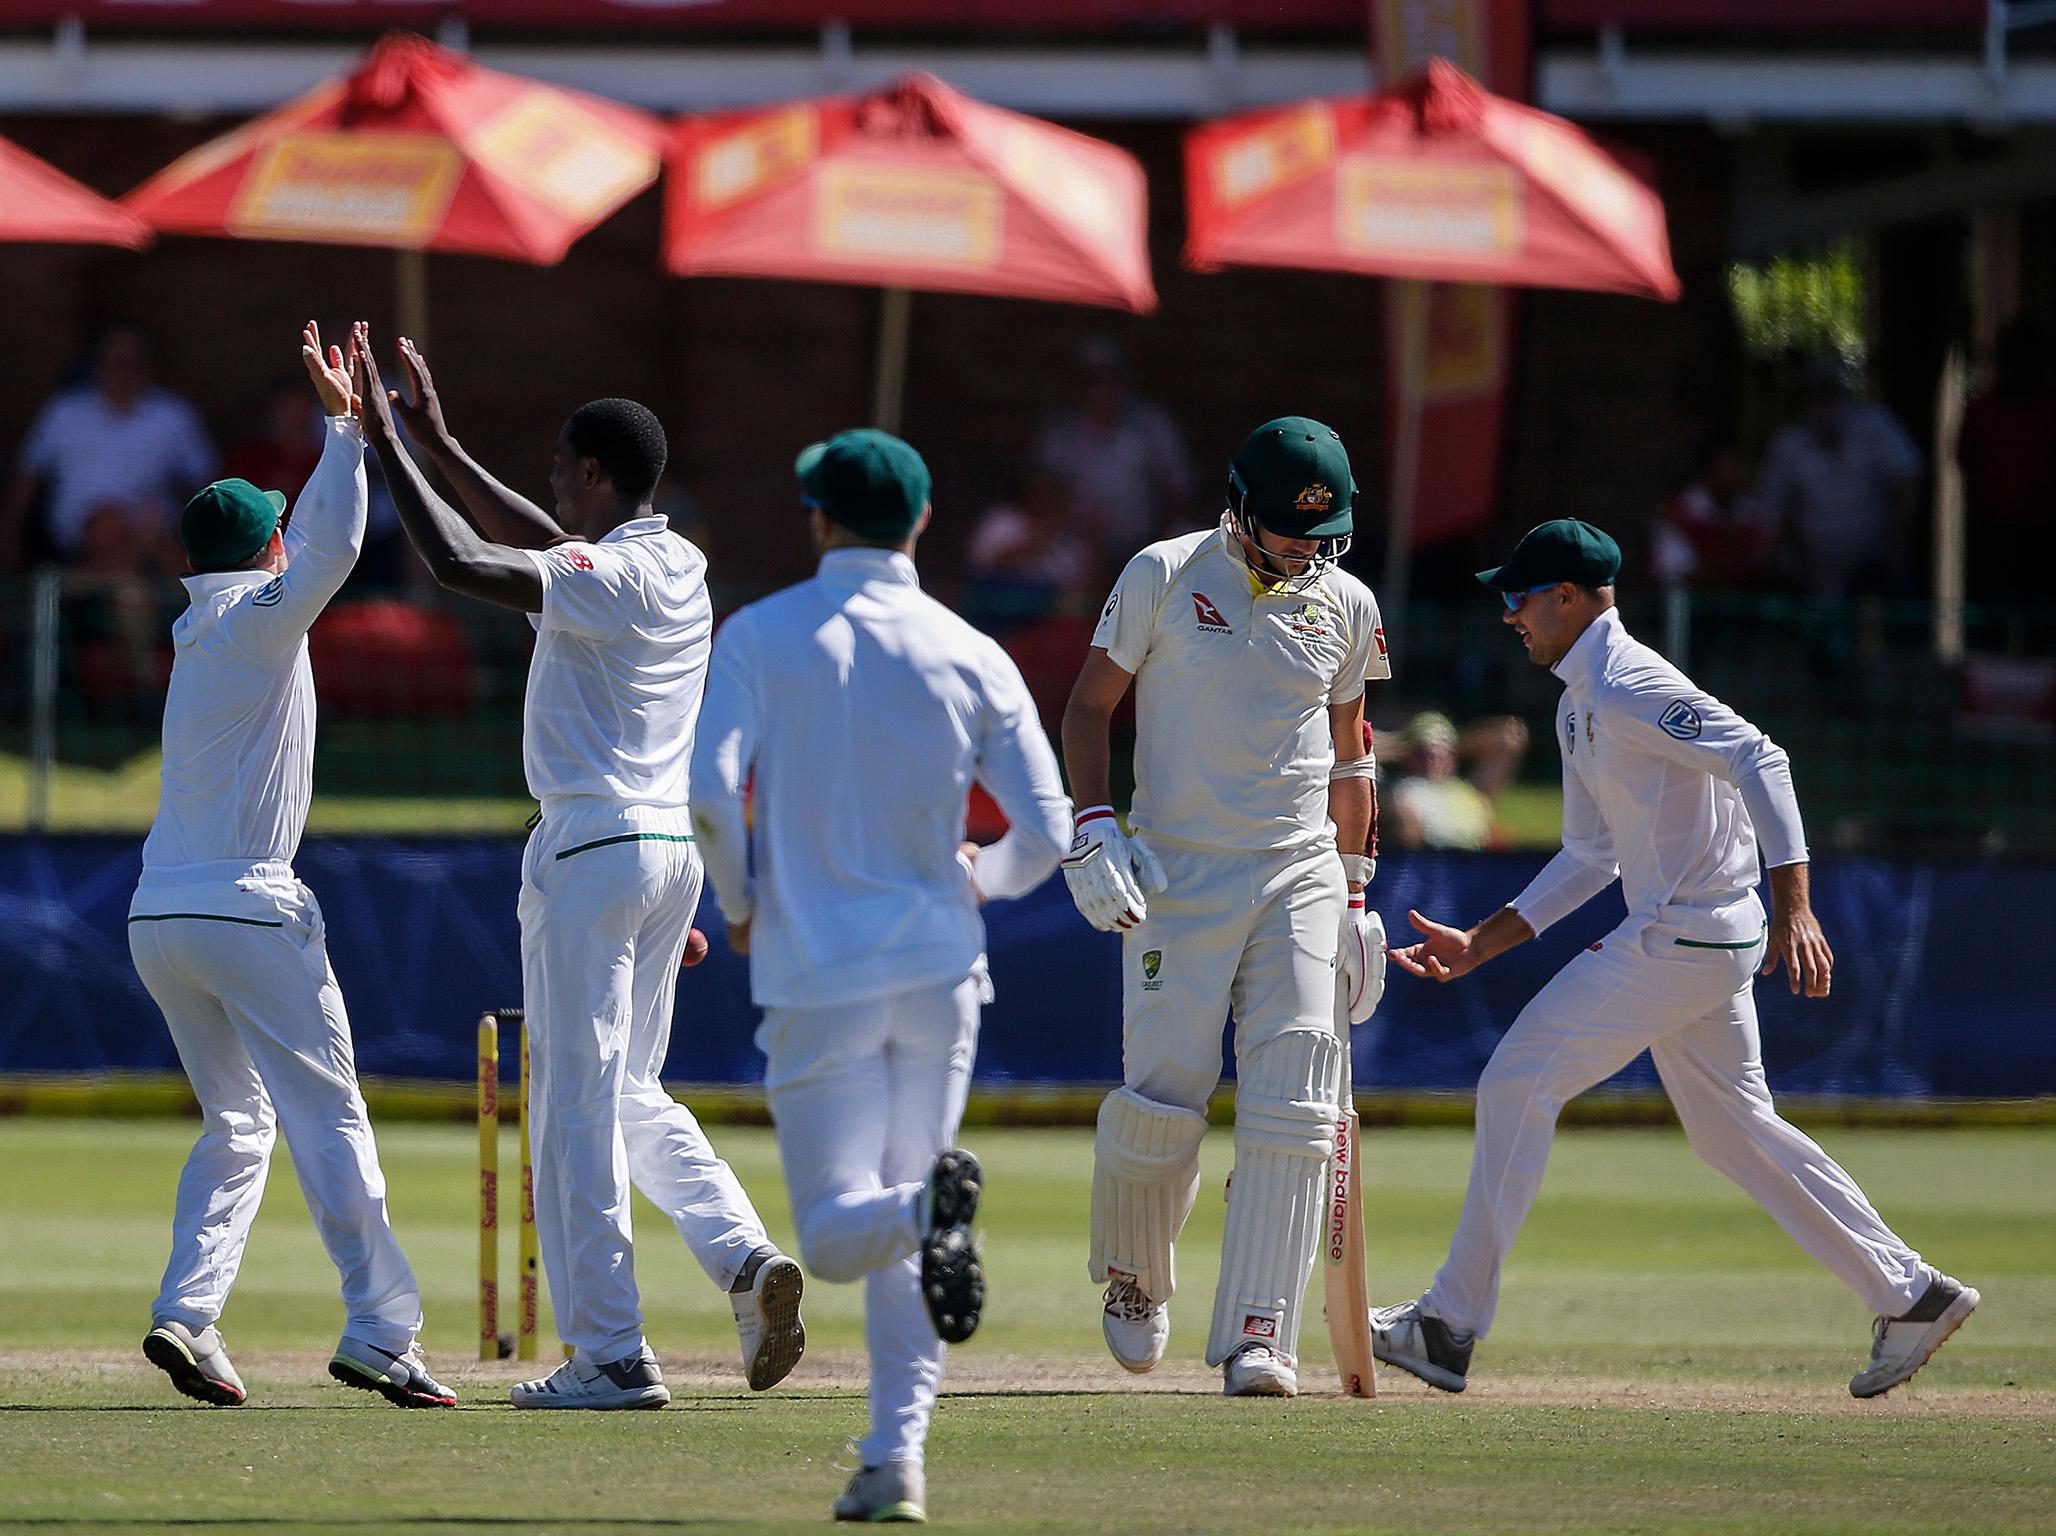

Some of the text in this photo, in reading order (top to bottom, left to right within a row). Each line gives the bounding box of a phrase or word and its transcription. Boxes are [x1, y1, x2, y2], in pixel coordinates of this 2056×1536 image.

[1197, 625, 1233, 636] QANTAS
[481, 1169, 496, 1229] Sunfoil
[1331, 1120, 1349, 1261] new balance
[481, 1279, 497, 1340] Sunfoil
[522, 1275, 536, 1335] Sunfoil
